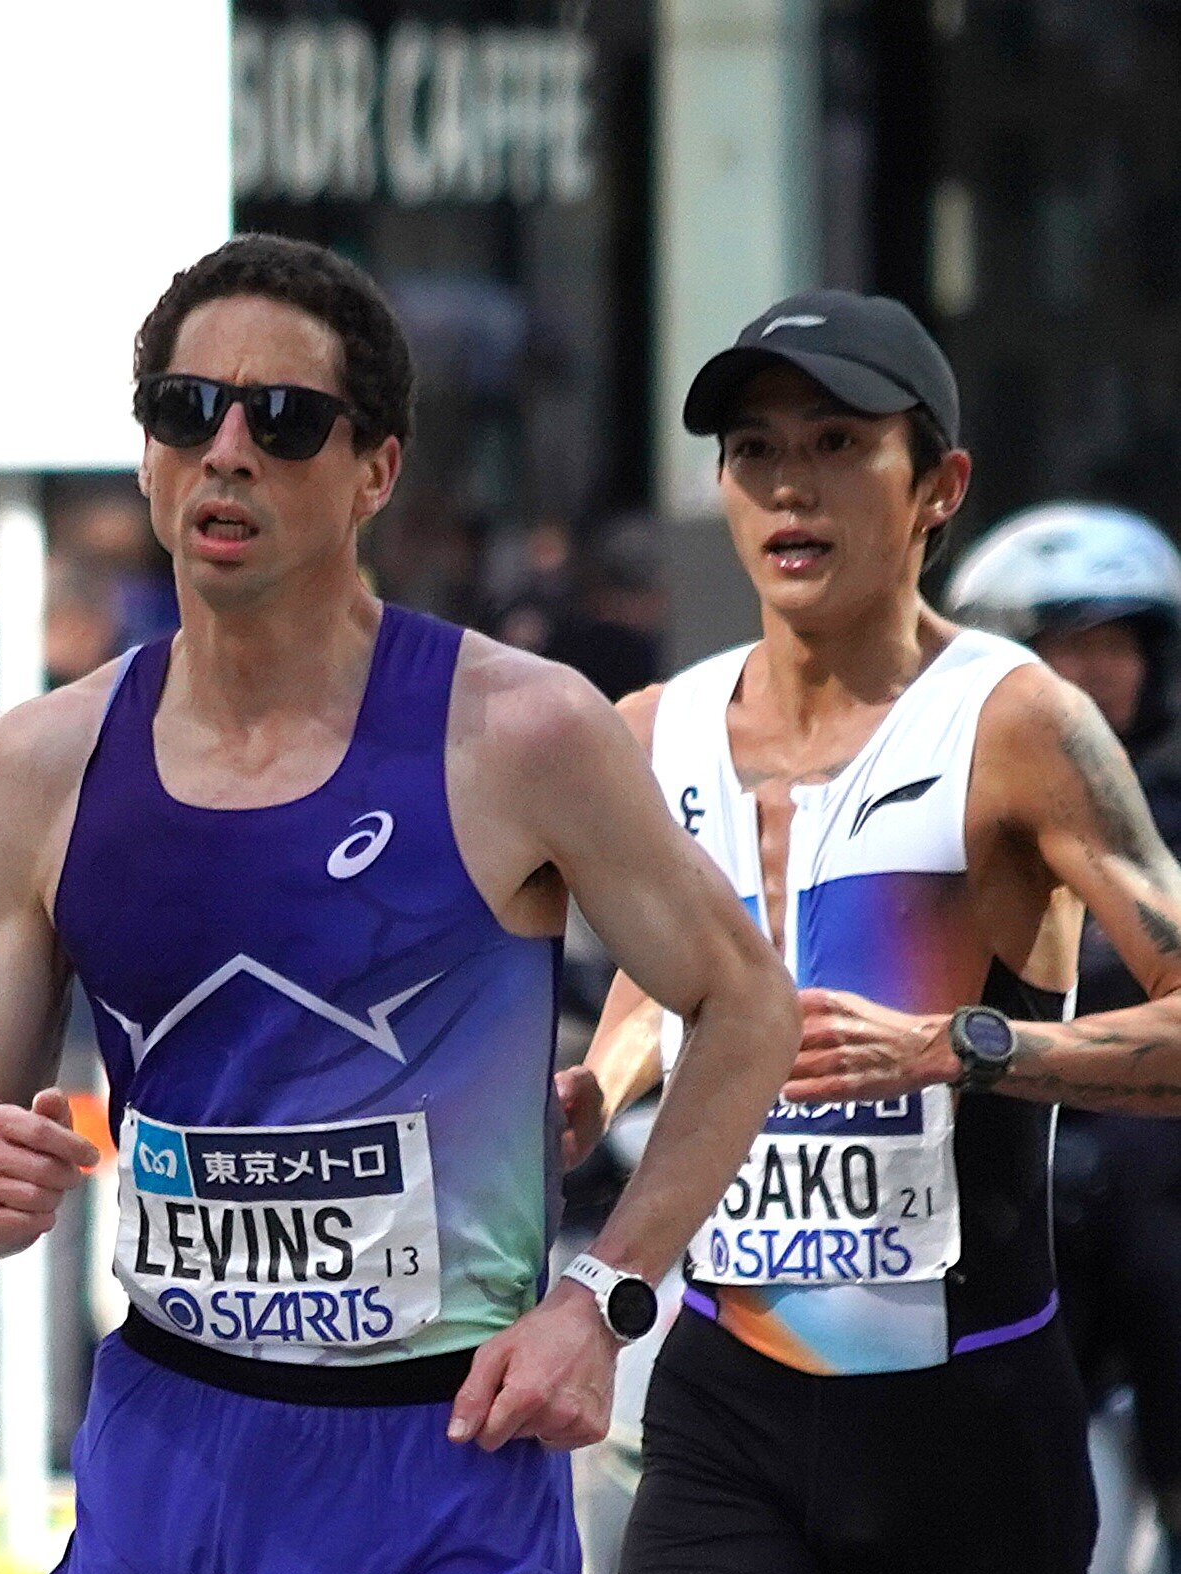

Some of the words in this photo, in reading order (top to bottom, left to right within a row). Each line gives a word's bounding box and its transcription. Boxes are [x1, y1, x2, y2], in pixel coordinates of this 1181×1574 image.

[201, 1144, 385, 1185] 東京メトロ
[712, 1144, 877, 1220] SAKO
[900, 1187, 933, 1218] 21
[135, 1195, 353, 1282] LEVINS
[386, 1247, 419, 1277] 13
[733, 1226, 912, 1279] STARTS
[210, 1286, 393, 1342] STARTS
